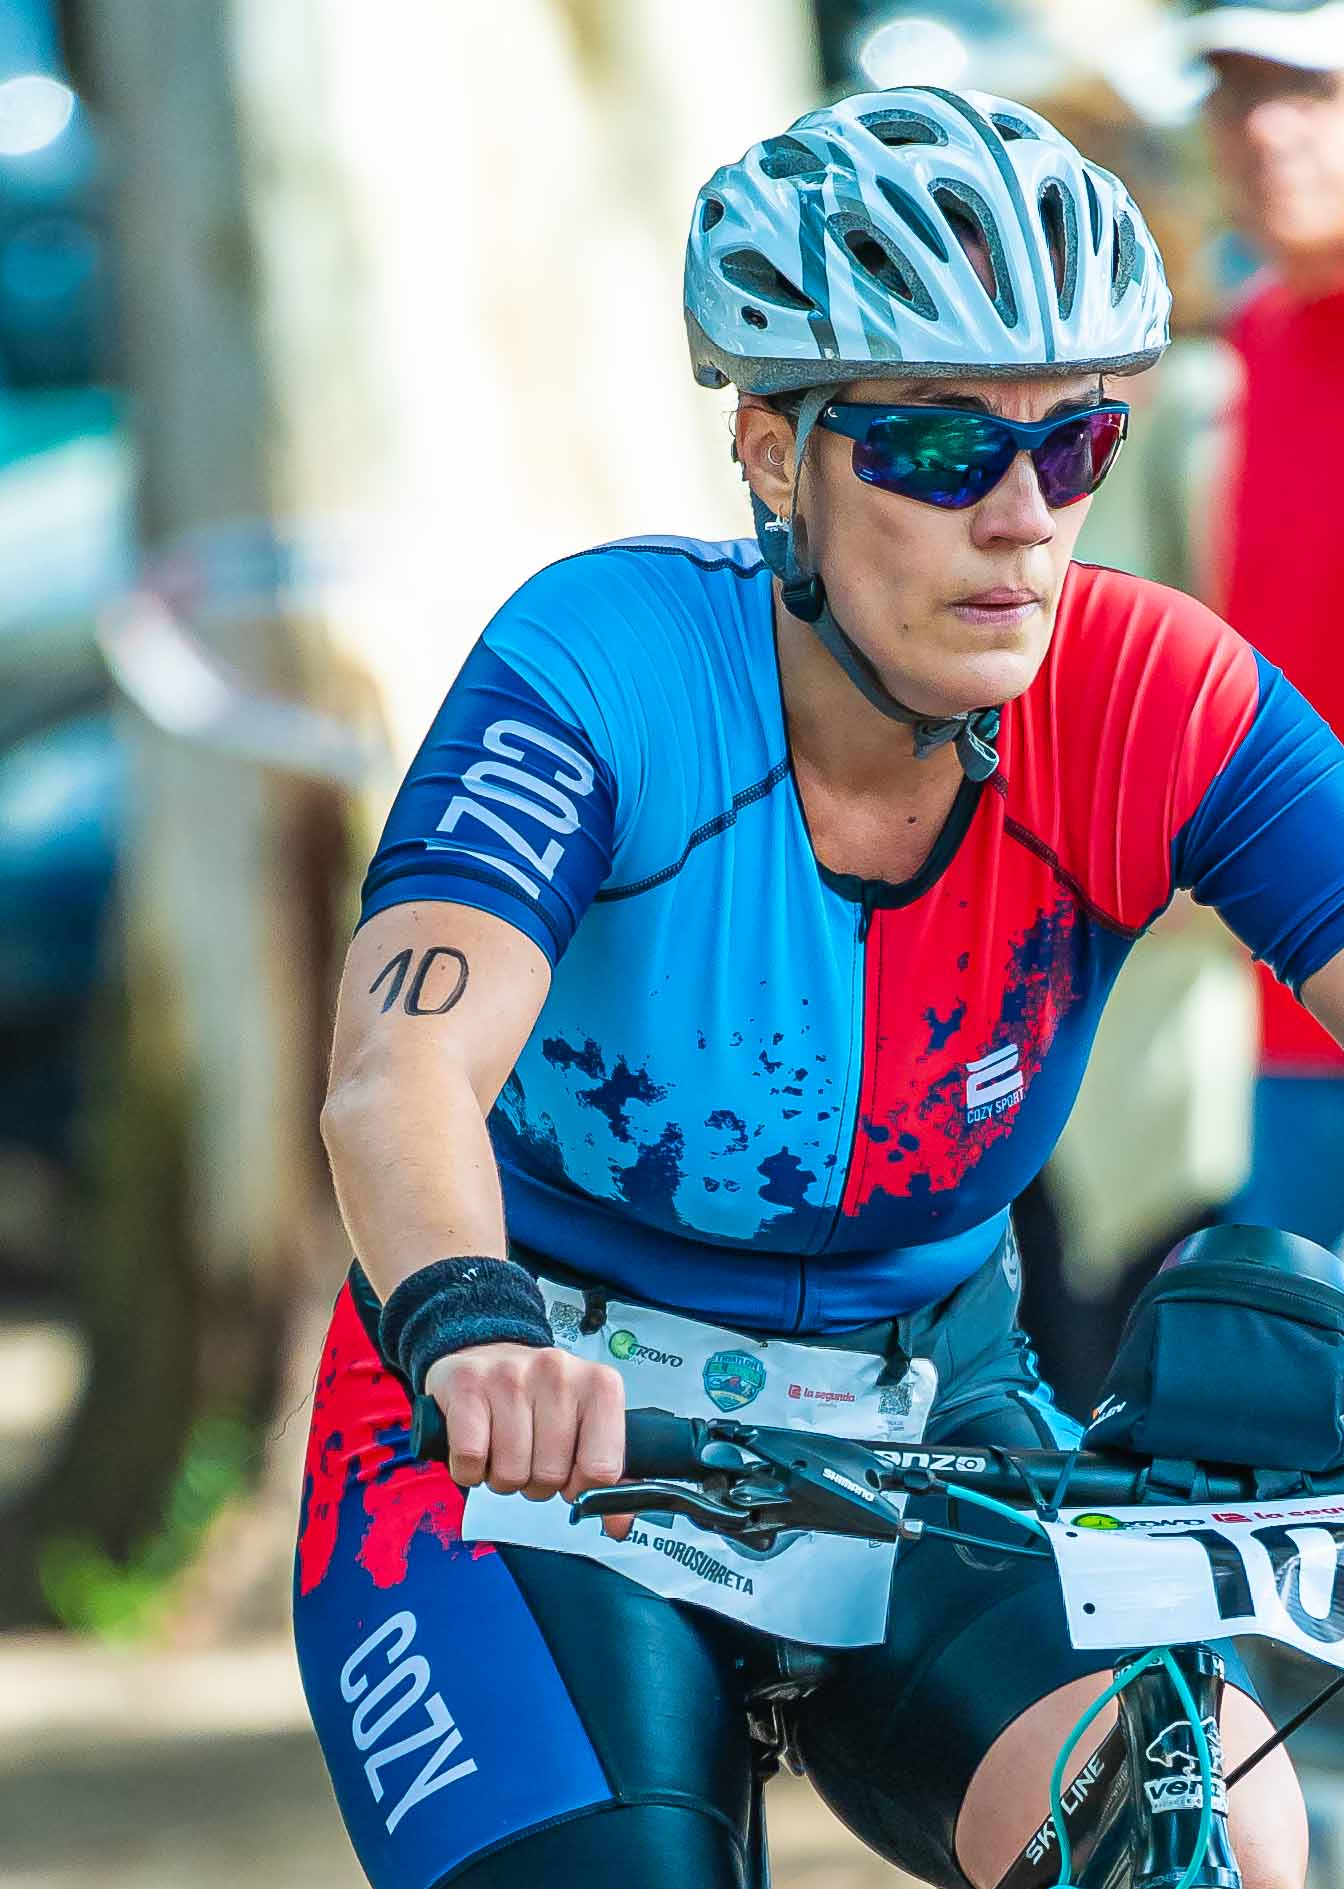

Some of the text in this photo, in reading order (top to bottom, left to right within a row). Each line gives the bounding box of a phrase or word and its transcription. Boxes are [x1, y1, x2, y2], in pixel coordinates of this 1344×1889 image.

[424, 720, 594, 900] COZY
[369, 946, 468, 1016] 10
[967, 1087, 1025, 1124] COZY SPORT
[822, 1468, 875, 1502] SHIMANO
[1254, 1511, 1285, 1520] la
[653, 1536, 754, 1595] GOROSURRETA
[340, 1610, 478, 1835] COZY
[1025, 1751, 1105, 1866] SKLINE
